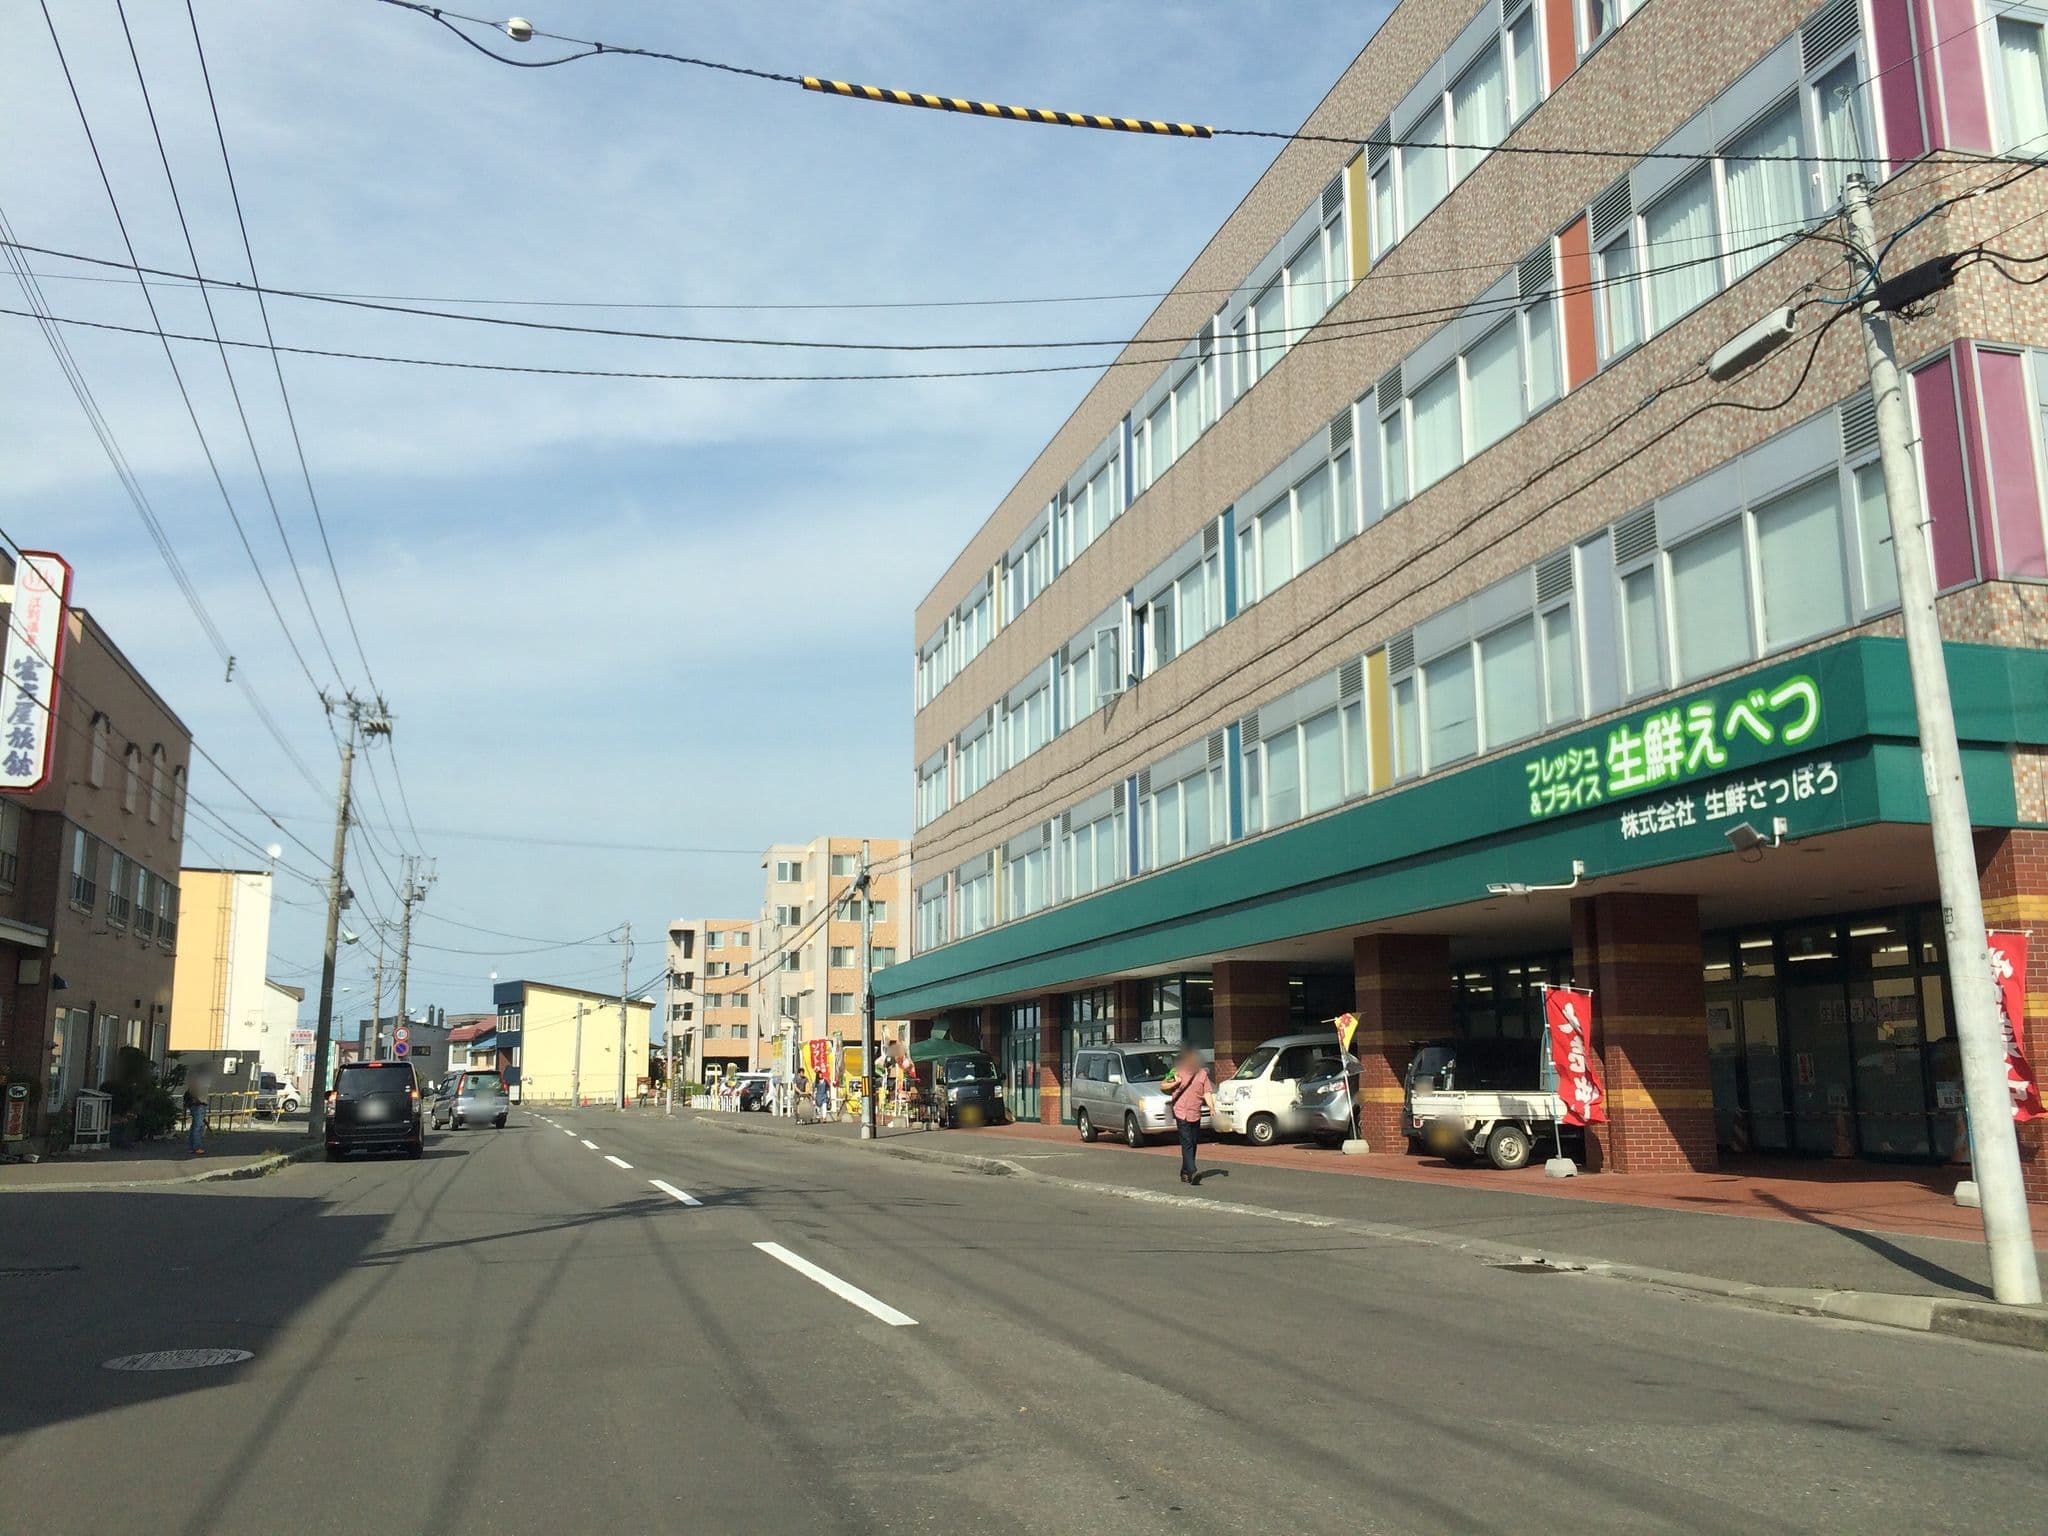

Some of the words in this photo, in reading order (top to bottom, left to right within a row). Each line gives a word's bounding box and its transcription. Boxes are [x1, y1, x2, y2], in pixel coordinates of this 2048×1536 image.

[1526, 747, 1599, 787] フレッシュ
[1606, 677, 1820, 794] 生鮮えべつ
[1620, 795, 1696, 840] 株式会社
[1704, 762, 1838, 820] 生鮮さっぽろ
